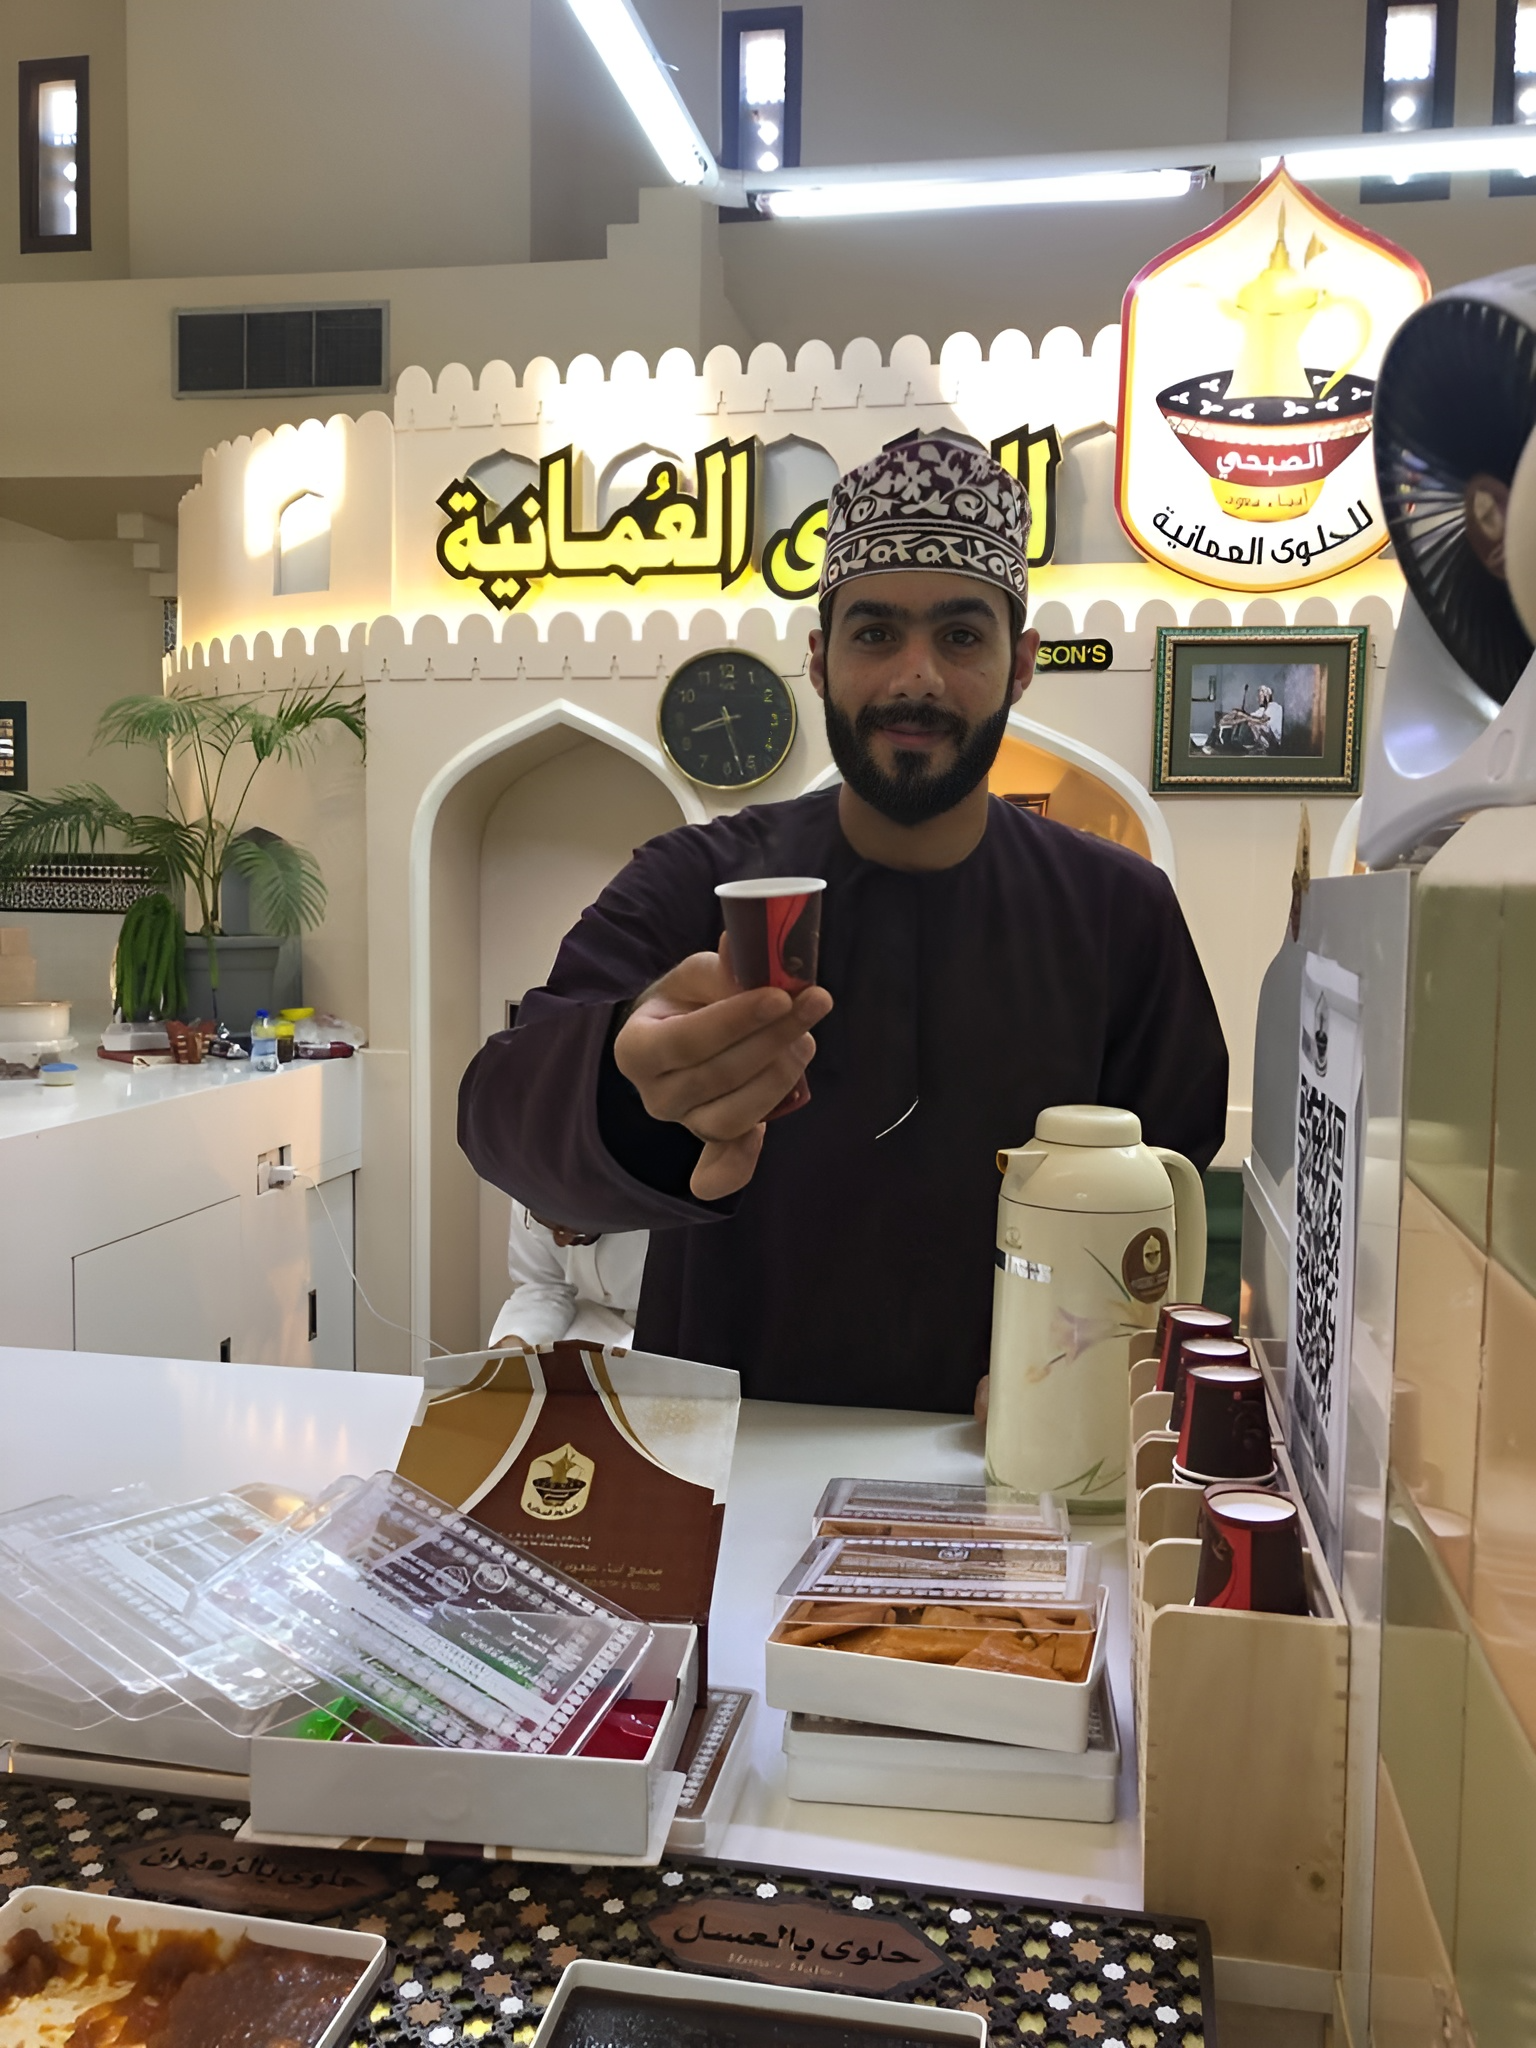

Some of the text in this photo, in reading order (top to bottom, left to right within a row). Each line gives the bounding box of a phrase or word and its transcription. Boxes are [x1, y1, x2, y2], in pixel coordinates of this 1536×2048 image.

[1216, 443, 1323, 480] الصبحي
[1152, 499, 1374, 567] للحلوى العمانية
[1036, 644, 1106, 666] SON'S
[673, 1915, 921, 1965] حلوى بالعسل
